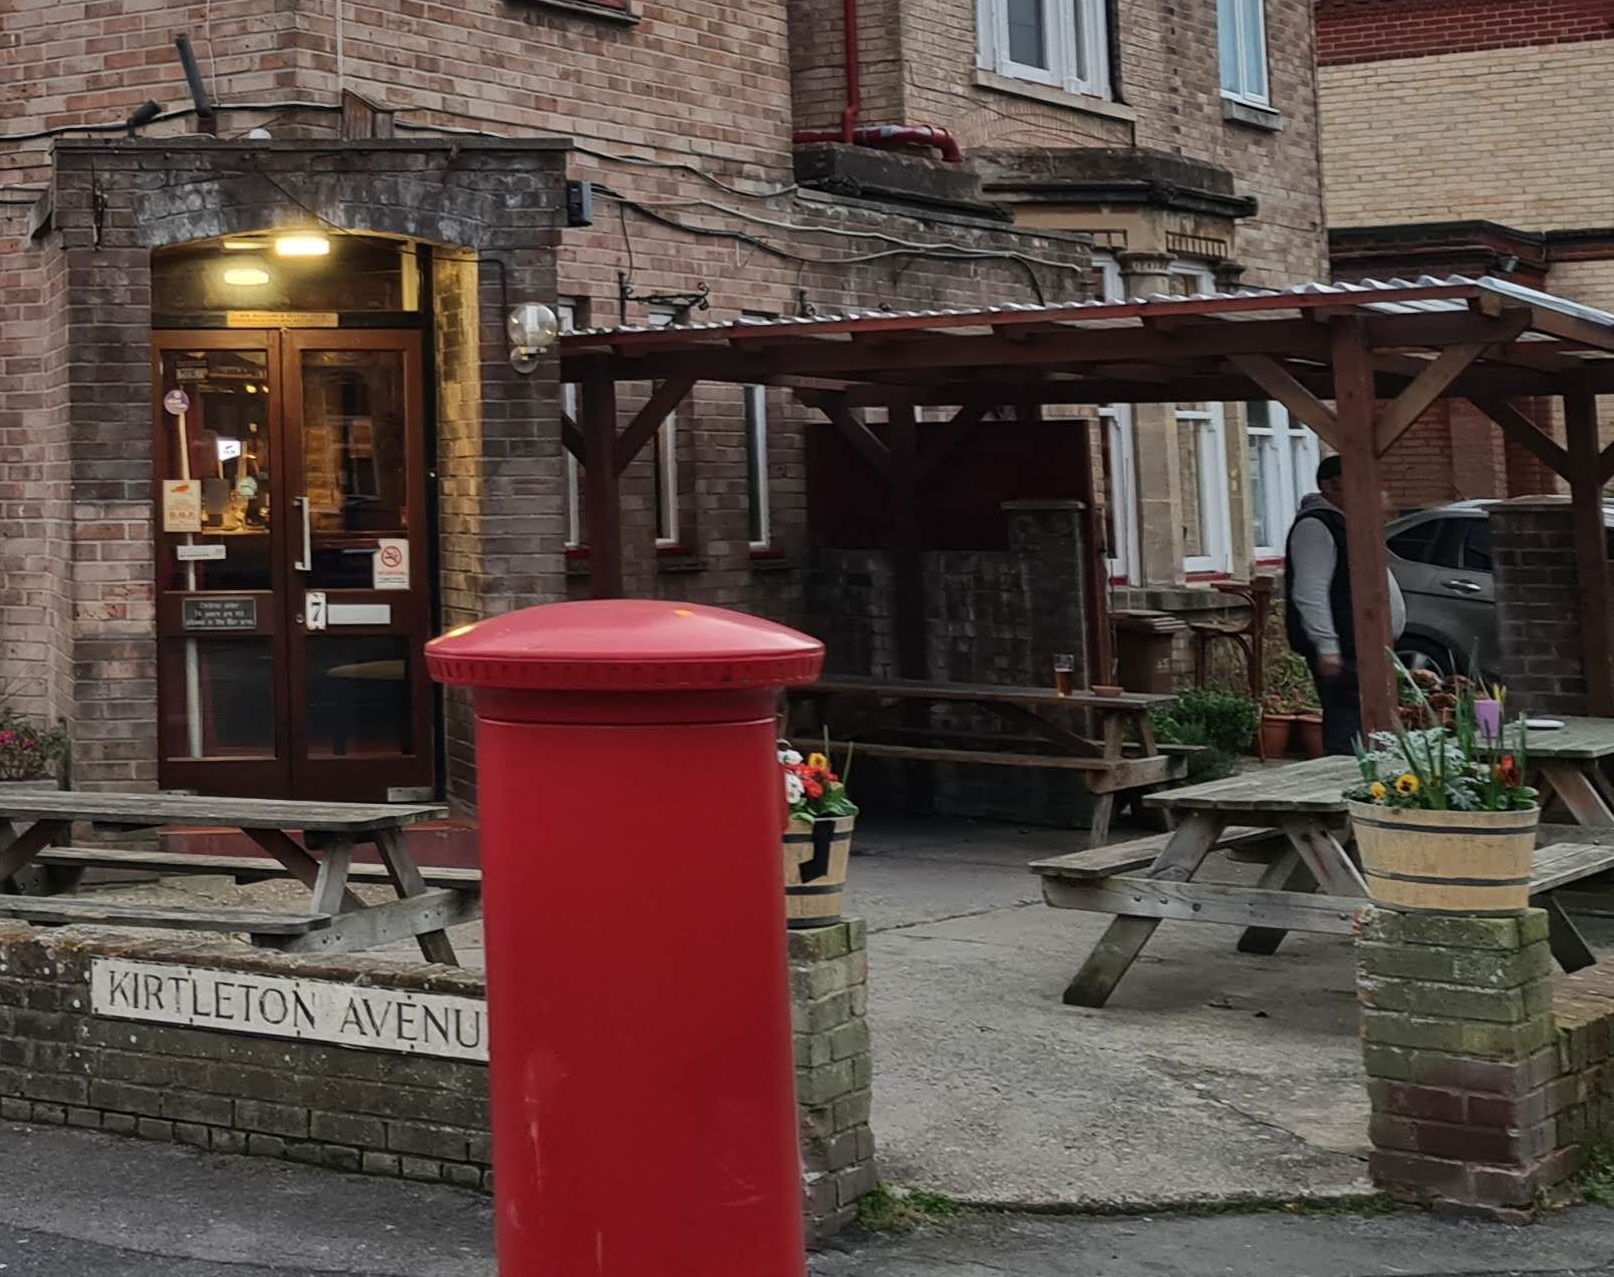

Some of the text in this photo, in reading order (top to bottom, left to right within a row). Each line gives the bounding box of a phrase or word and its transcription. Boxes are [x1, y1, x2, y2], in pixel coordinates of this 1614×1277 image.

[311, 601, 322, 622] 7
[109, 970, 490, 1049] KIRTLETON AVENU
